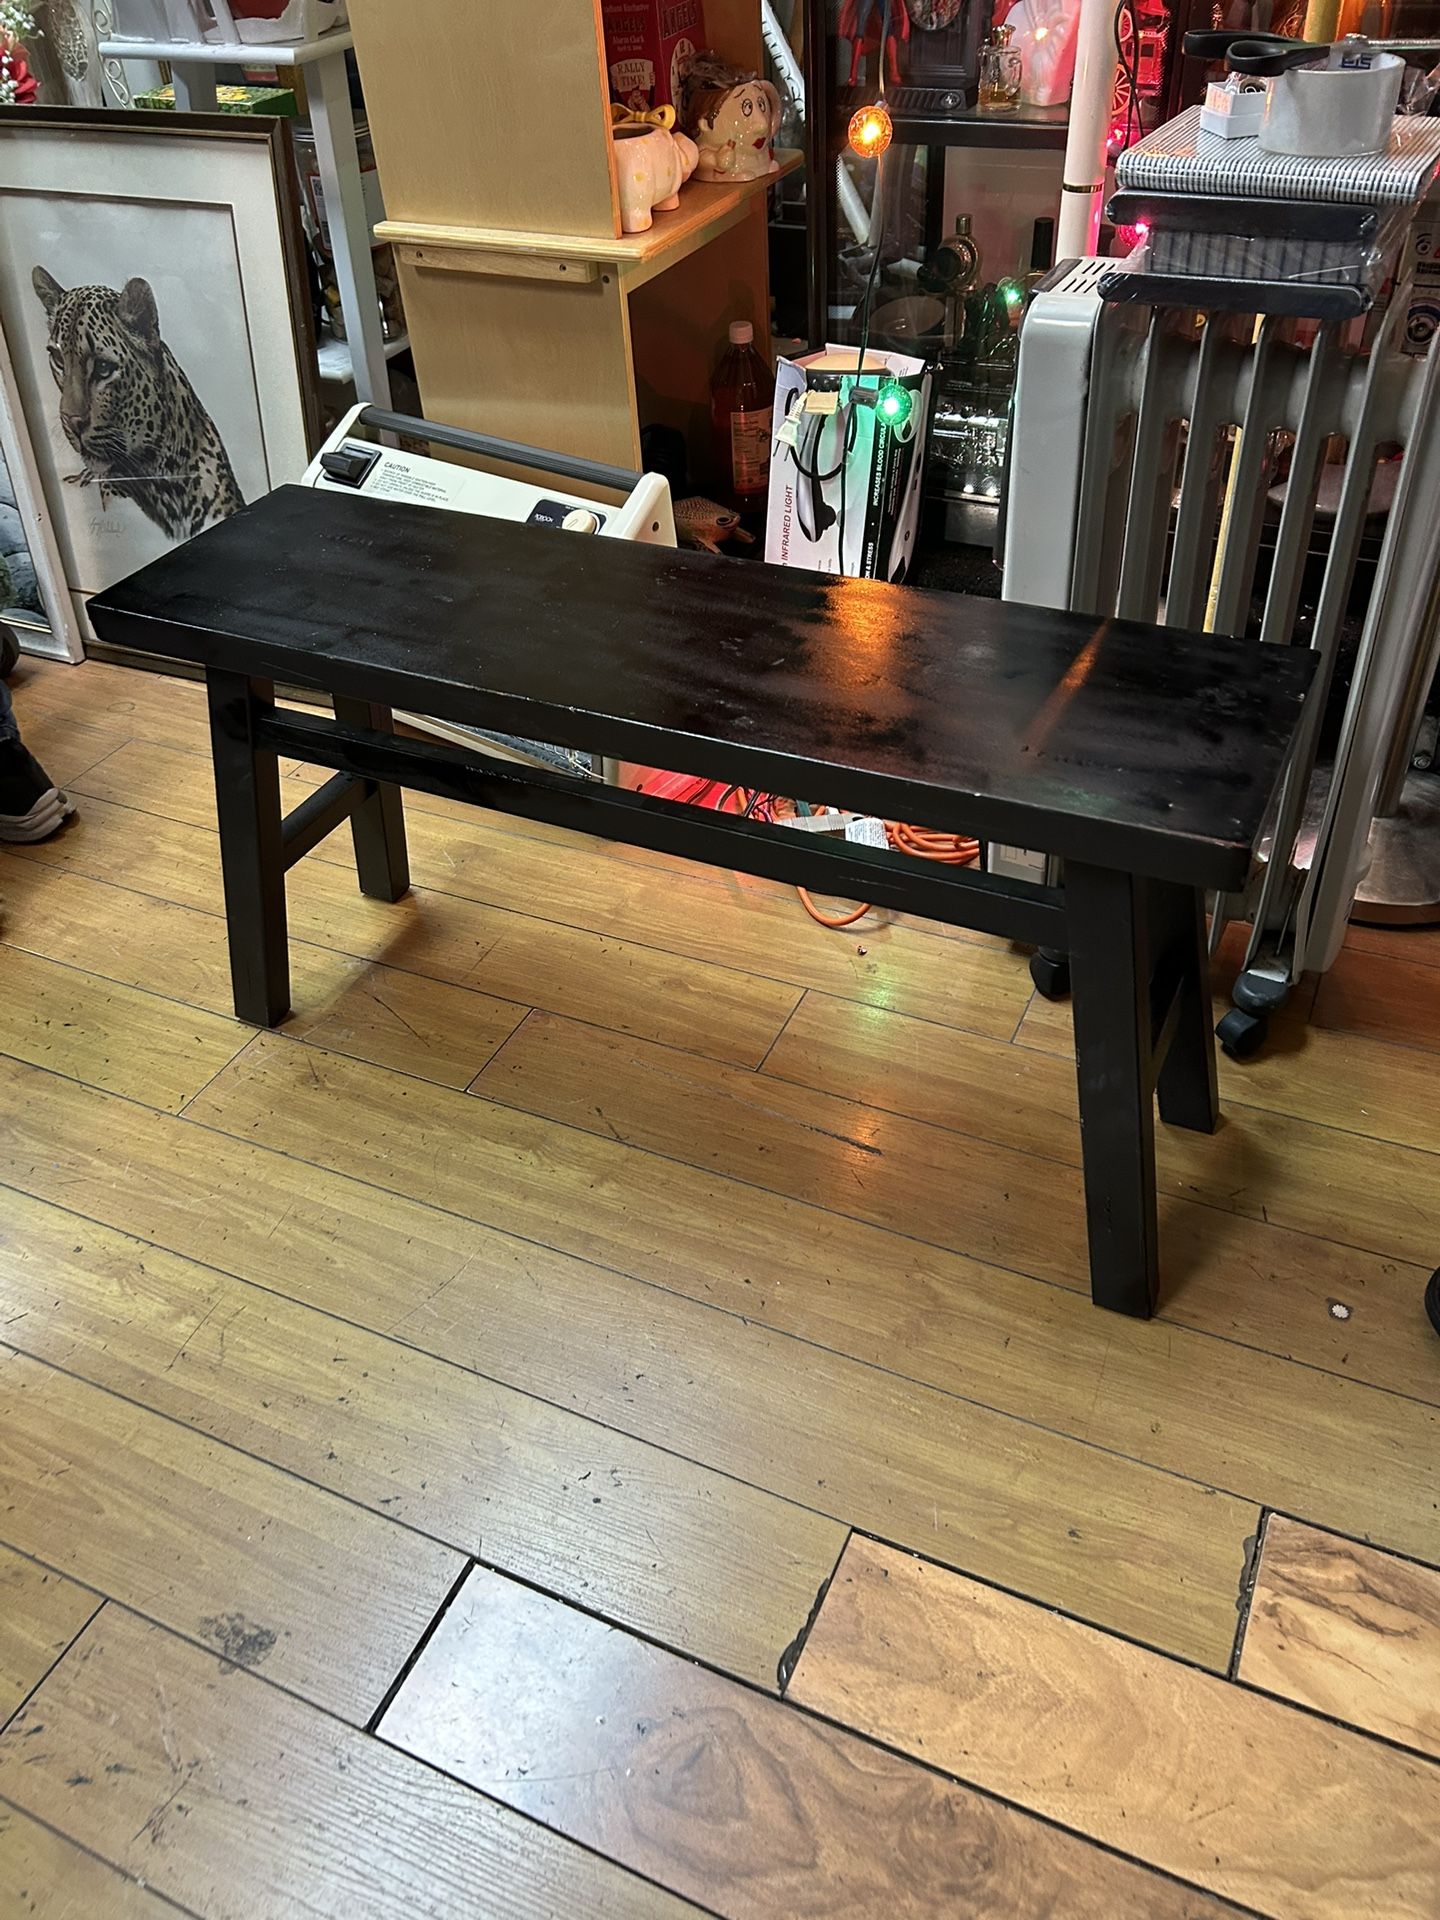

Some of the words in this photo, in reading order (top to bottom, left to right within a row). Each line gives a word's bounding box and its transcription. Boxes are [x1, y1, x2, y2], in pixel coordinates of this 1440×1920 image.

[617, 62, 645, 74] RALLY
[621, 76, 645, 87] TIME!
[384, 461, 411, 474] CAUTION
[876, 450, 884, 471] BLOOD
[784, 484, 794, 514] LIGHT
[873, 472, 882, 506] INCREASES
[781, 515, 792, 561] INFRARED
